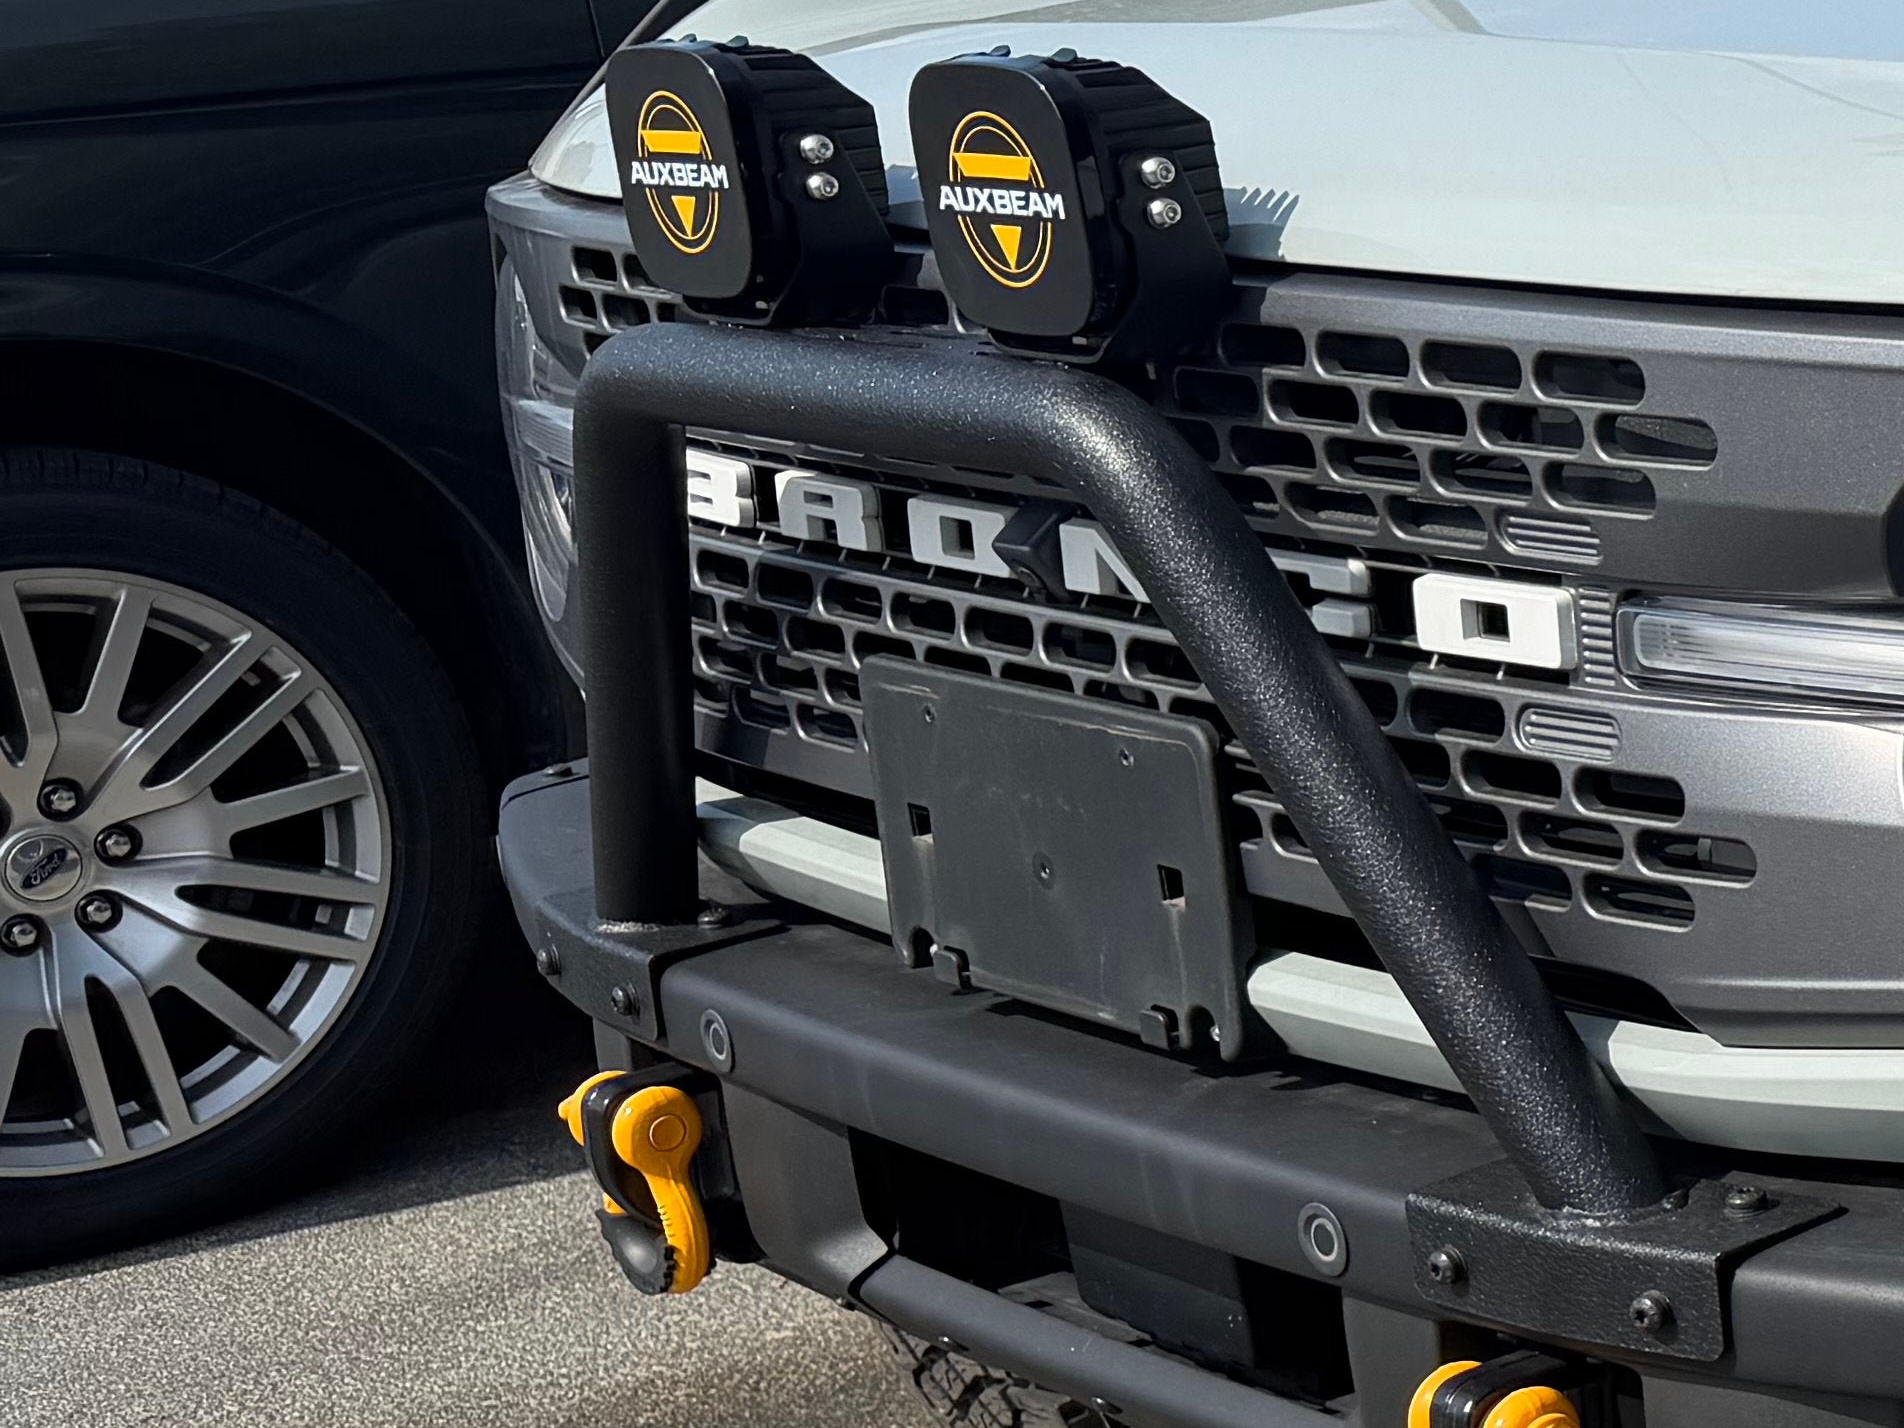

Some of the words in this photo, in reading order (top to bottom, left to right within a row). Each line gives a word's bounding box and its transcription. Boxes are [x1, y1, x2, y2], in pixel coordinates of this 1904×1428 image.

[631, 160, 730, 190] AUXBEAM
[939, 184, 1067, 221] AUXBEAM
[31, 853, 61, 885] Ford
